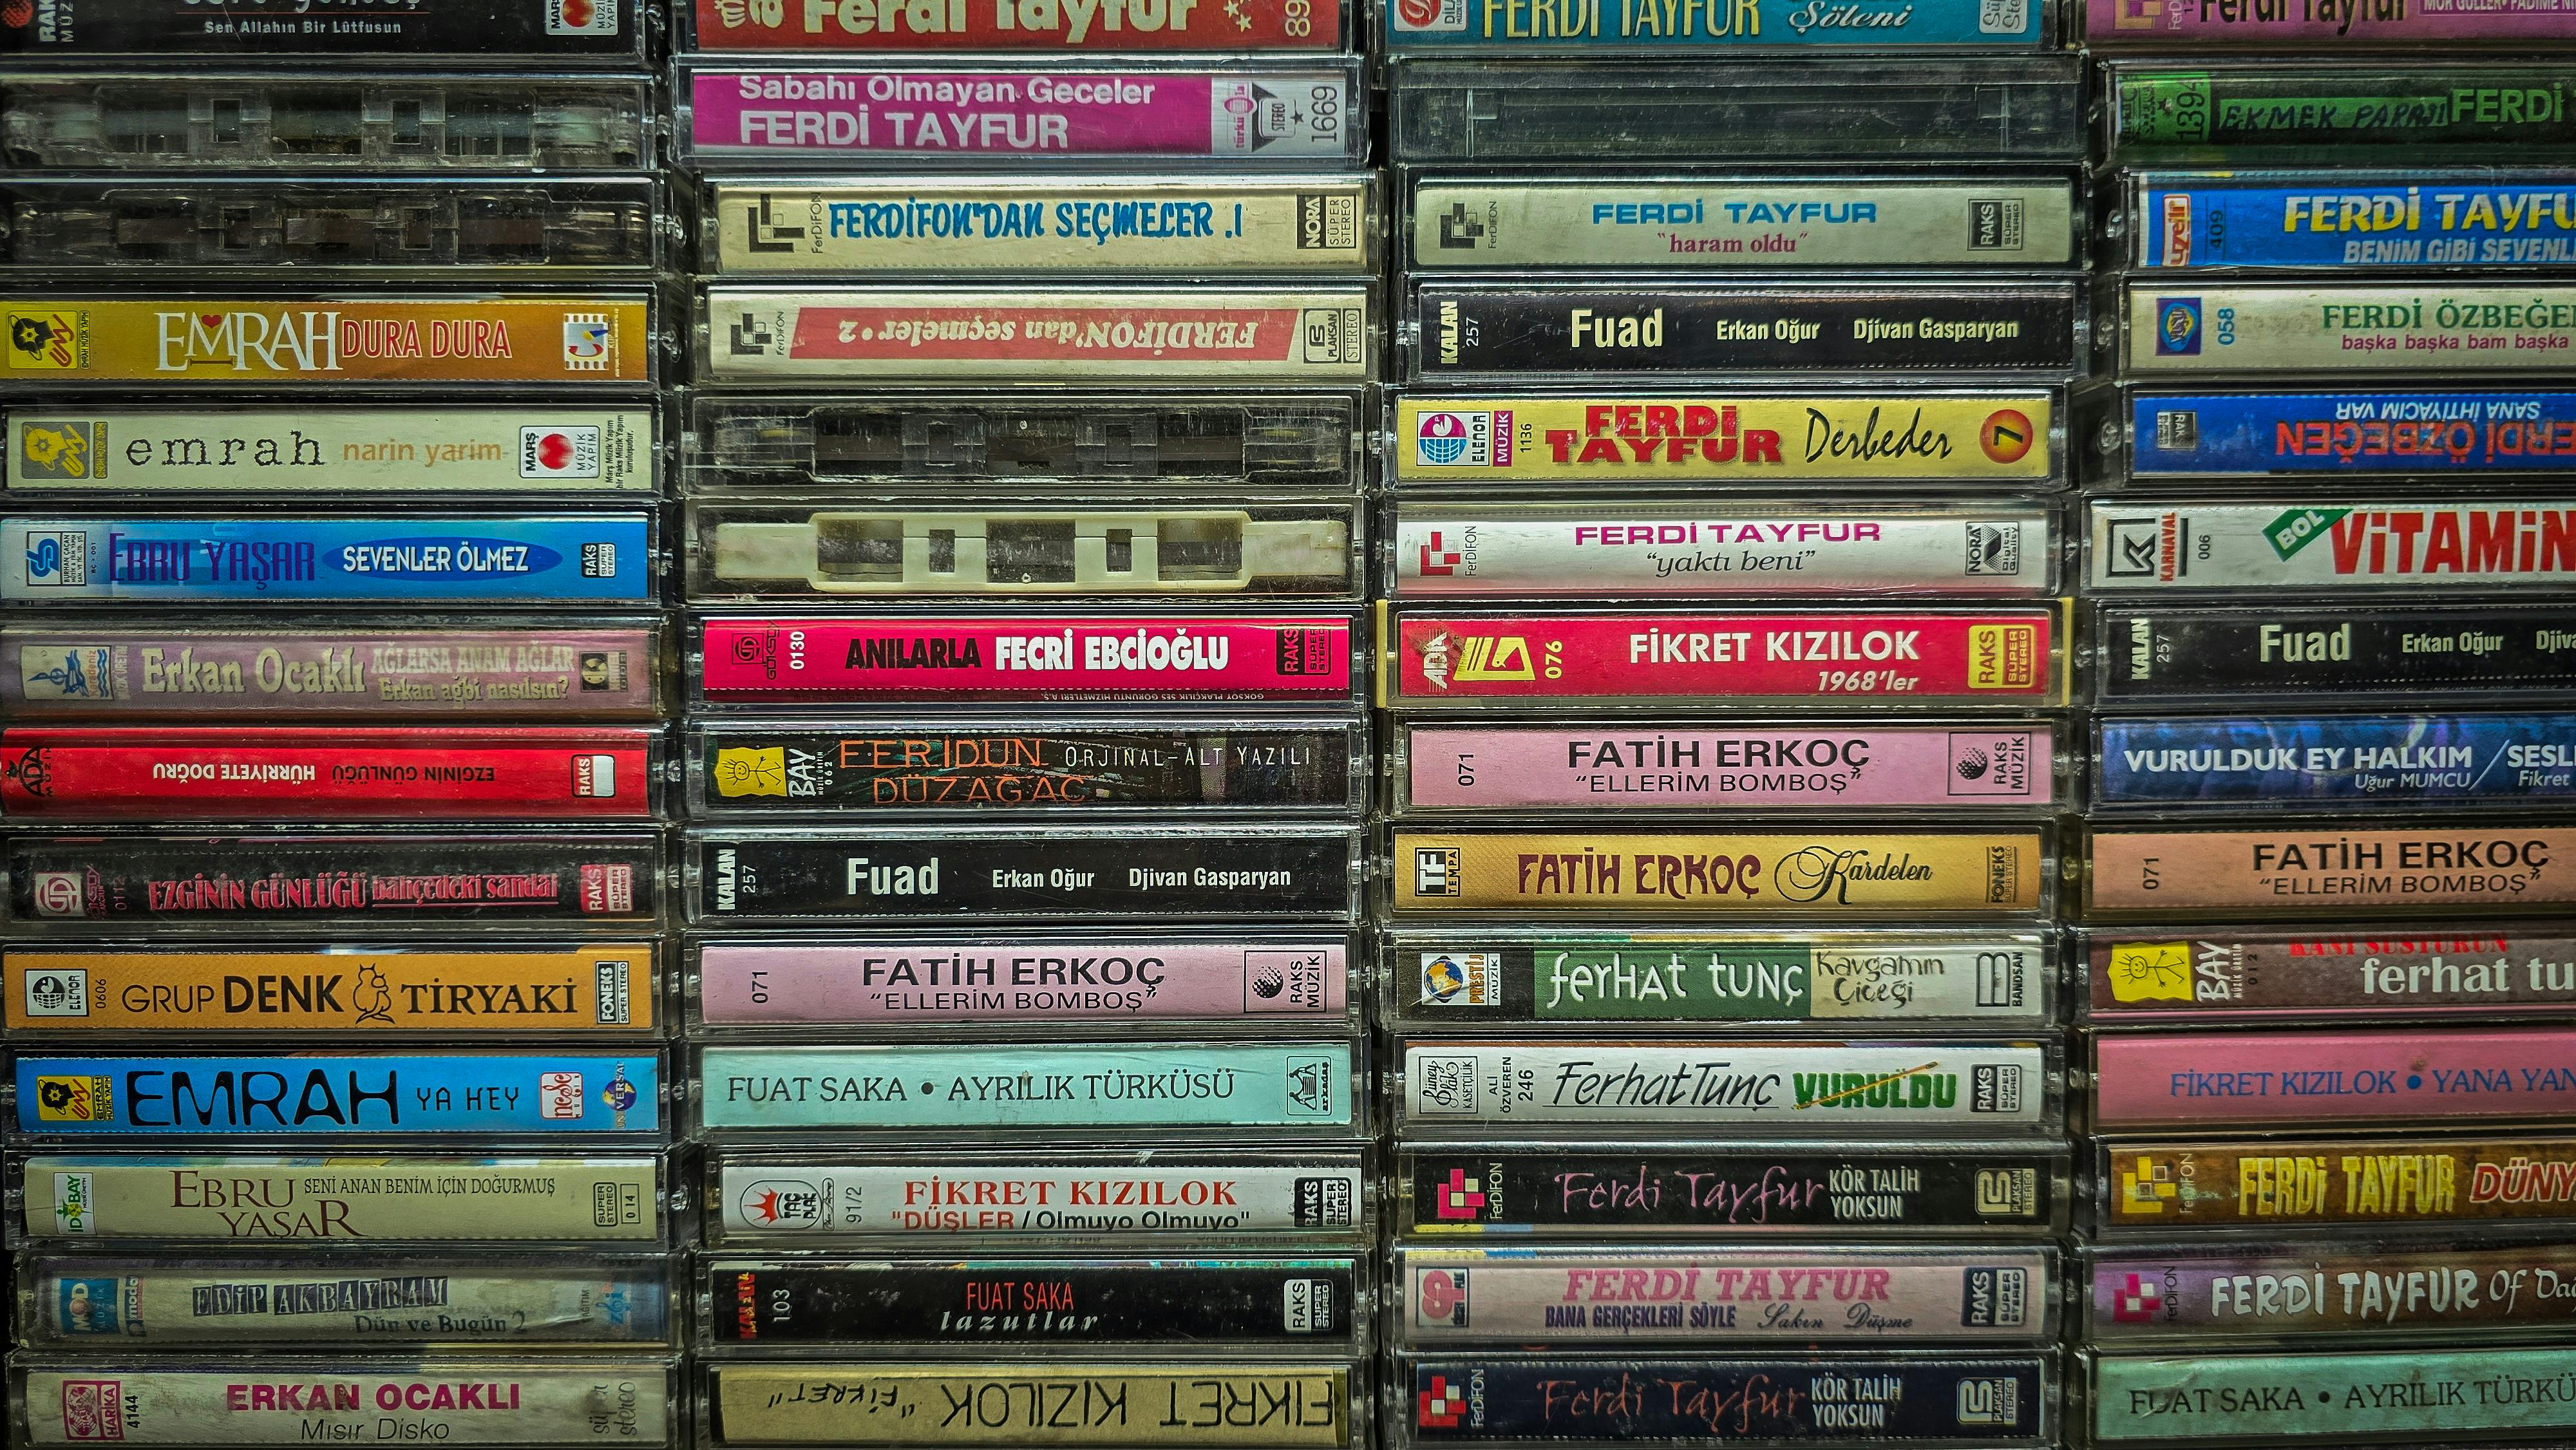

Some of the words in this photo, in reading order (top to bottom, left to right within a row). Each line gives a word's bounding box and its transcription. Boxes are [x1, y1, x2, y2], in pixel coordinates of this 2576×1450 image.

[205, 21, 233, 34] Sen
[240, 20, 297, 34] Allahın
[302, 21, 326, 34] Bir
[740, 76, 855, 102] Sabahı
[867, 77, 1015, 105] Olmayan
[1028, 77, 1155, 105] Geceler
[740, 108, 869, 146] FERDİ
[886, 112, 1068, 147] TAYFUR
[1309, 86, 1338, 143] 1669
[1056, 202, 1215, 245] SEÇMELER
[1305, 196, 1320, 246] NORA
[1327, 198, 1338, 245] SÜPER
[1341, 198, 1351, 246] STEREO
[1593, 199, 1703, 225] FERDİ
[1725, 203, 1877, 224] TAYFUR
[2284, 187, 2421, 232] FERDİ
[2344, 240, 2421, 264] BENİM
[2427, 238, 2476, 263] GİBİ
[2217, 308, 2235, 345] 058
[2322, 298, 2422, 330] FERDİ
[155, 311, 344, 372] EMRAH
[343, 319, 422, 359] DURA
[432, 319, 513, 359] DURA
[2342, 335, 2397, 352] başka
[2405, 334, 2459, 351] başka
[2468, 333, 2506, 348] bam
[2515, 332, 2568, 350] başka
[605, 420, 615, 442] Yapım
[616, 415, 625, 438] Yapım
[1497, 413, 1510, 463] MÜZİK
[1520, 423, 1533, 454] 1136
[1586, 405, 1738, 438] FERDİ
[1805, 407, 1952, 462] Derbeder
[126, 431, 327, 467] emrah
[343, 438, 415, 461] narin
[424, 438, 502, 468] yarim
[526, 432, 539, 471] MARŞ
[576, 433, 585, 471] MÜZİK
[587, 433, 596, 471] YAPIM
[605, 444, 614, 464] Müzik
[1546, 429, 1783, 463] TAYFUR
[1969, 525, 1981, 572] NORA
[2160, 513, 2175, 581] KARNAVAL
[2198, 534, 2211, 560] 006
[2276, 511, 2325, 552] BOL
[109, 533, 190, 581] EBRU
[205, 541, 315, 590] YAŞAR
[343, 546, 451, 571] SEVENLER
[457, 541, 529, 572] ÖLMEZ
[790, 632, 805, 670] 0130
[845, 639, 981, 670] ANILARLA
[995, 628, 1073, 670] FECRİ
[1085, 628, 1228, 670] EBCİOĞLU
[1547, 641, 1562, 679] 076
[1630, 627, 1748, 664] FİKRET
[1765, 630, 1918, 661] KIZILOK
[1980, 631, 1995, 683] RAKS
[2260, 625, 2351, 662] Fuad
[2402, 632, 2453, 653] Erkan
[2459, 630, 2503, 657] Oğur
[142, 648, 244, 693] Erkan
[258, 648, 366, 695] Ocaklı
[153, 764, 217, 783] DOĞRU
[221, 763, 315, 783] HÜRRİYETE
[332, 764, 415, 786] GÜNLÜĞÜ
[424, 766, 496, 785] EZGİNİN
[2125, 746, 2297, 772] VURULDUK
[2307, 748, 2345, 770] EY
[2354, 746, 2472, 769] HALKIM
[2356, 774, 2396, 792] Uğur
[2401, 772, 2471, 788] MUMCU
[2518, 770, 2569, 787] Fikret
[1517, 847, 1620, 894] FATİH
[1634, 854, 1760, 899] ERKOÇ
[1775, 845, 1932, 905] Kardelen
[2143, 858, 2159, 889] 071
[2253, 838, 2383, 871] FATİH
[2400, 840, 2548, 875] ERKOÇ
[718, 849, 736, 910] KALAN
[743, 865, 757, 894] 257
[848, 858, 940, 895] Fuad
[992, 869, 1044, 889] Erkan
[1050, 867, 1095, 892] Oğur
[1129, 867, 1188, 890] Djivan
[1193, 869, 1291, 893] Gasparyan
[752, 970, 768, 1004] 071
[862, 953, 1005, 986] FATİH
[1012, 957, 1166, 992] ERKOÇ
[1289, 961, 1303, 1005] RAKS
[1306, 955, 1320, 1008] MÜZİK
[2012, 952, 2023, 1007] BANDSAN
[2361, 956, 2510, 994] ferhat
[95, 977, 107, 1008] 0606
[122, 984, 215, 1013] GRUP
[224, 975, 343, 1013] DENK
[401, 977, 578, 1014] TİRYAKİ
[129, 1069, 399, 1127] EMRAH
[417, 1088, 451, 1111] YA
[467, 1088, 518, 1111] HEY
[728, 1076, 815, 1101] FUAT
[820, 1076, 907, 1102] SAKA
[947, 1075, 1077, 1100] AYRILIK
[1083, 1069, 1235, 1100] TÜRKÜSÜ
[1487, 1076, 1498, 1096] ALİ
[1500, 1057, 1511, 1113] ÖZVEREN
[1517, 1069, 1533, 1101] 246
[2171, 1069, 2273, 1096] FİKRET
[2280, 1071, 2396, 1095] KIZILOK
[2432, 1069, 2511, 1093] YANA
[169, 1171, 294, 1209] EBRU
[305, 1177, 337, 1194] SENİ
[341, 1177, 383, 1194] ANAN
[386, 1177, 433, 1194] BENİM
[436, 1176, 467, 1197] İÇİN
[471, 1174, 555, 1198] DOĞURMUŞ
[598, 1185, 606, 1223] SUPER
[846, 1186, 862, 1222] 91/2
[905, 1175, 1054, 1205] FİKRET
[1070, 1180, 1237, 1206] KIZILOK
[1553, 1165, 1664, 1214] Ferdi
[1676, 1165, 1824, 1223] Tayfur
[1829, 1169, 1865, 1191] KÖR
[1870, 1167, 1918, 1192] TALİH
[1831, 1196, 1902, 1219] YOKSUN
[774, 1290, 790, 1323] 103
[967, 1282, 1017, 1310] FUAT
[1023, 1283, 1073, 1310] SAKA
[1293, 1283, 1306, 1328] RAKS
[2211, 1262, 2324, 1317] FERDİ
[2338, 1266, 2480, 1324] TAYFUR
[941, 1312, 1101, 1333] lazutlar
[1546, 1308, 1586, 1328] BANA
[1592, 1306, 1682, 1335] GERÇEKLERİ
[1690, 1304, 1735, 1329] SÖYLE
[105, 1387, 117, 1438] HARİKA
[127, 1395, 140, 1429] 4144
[227, 1384, 361, 1411] ERKAN
[376, 1383, 519, 1410] OCAKLI
[301, 1418, 364, 1440] Mısır
[377, 1418, 450, 1440] Disko
